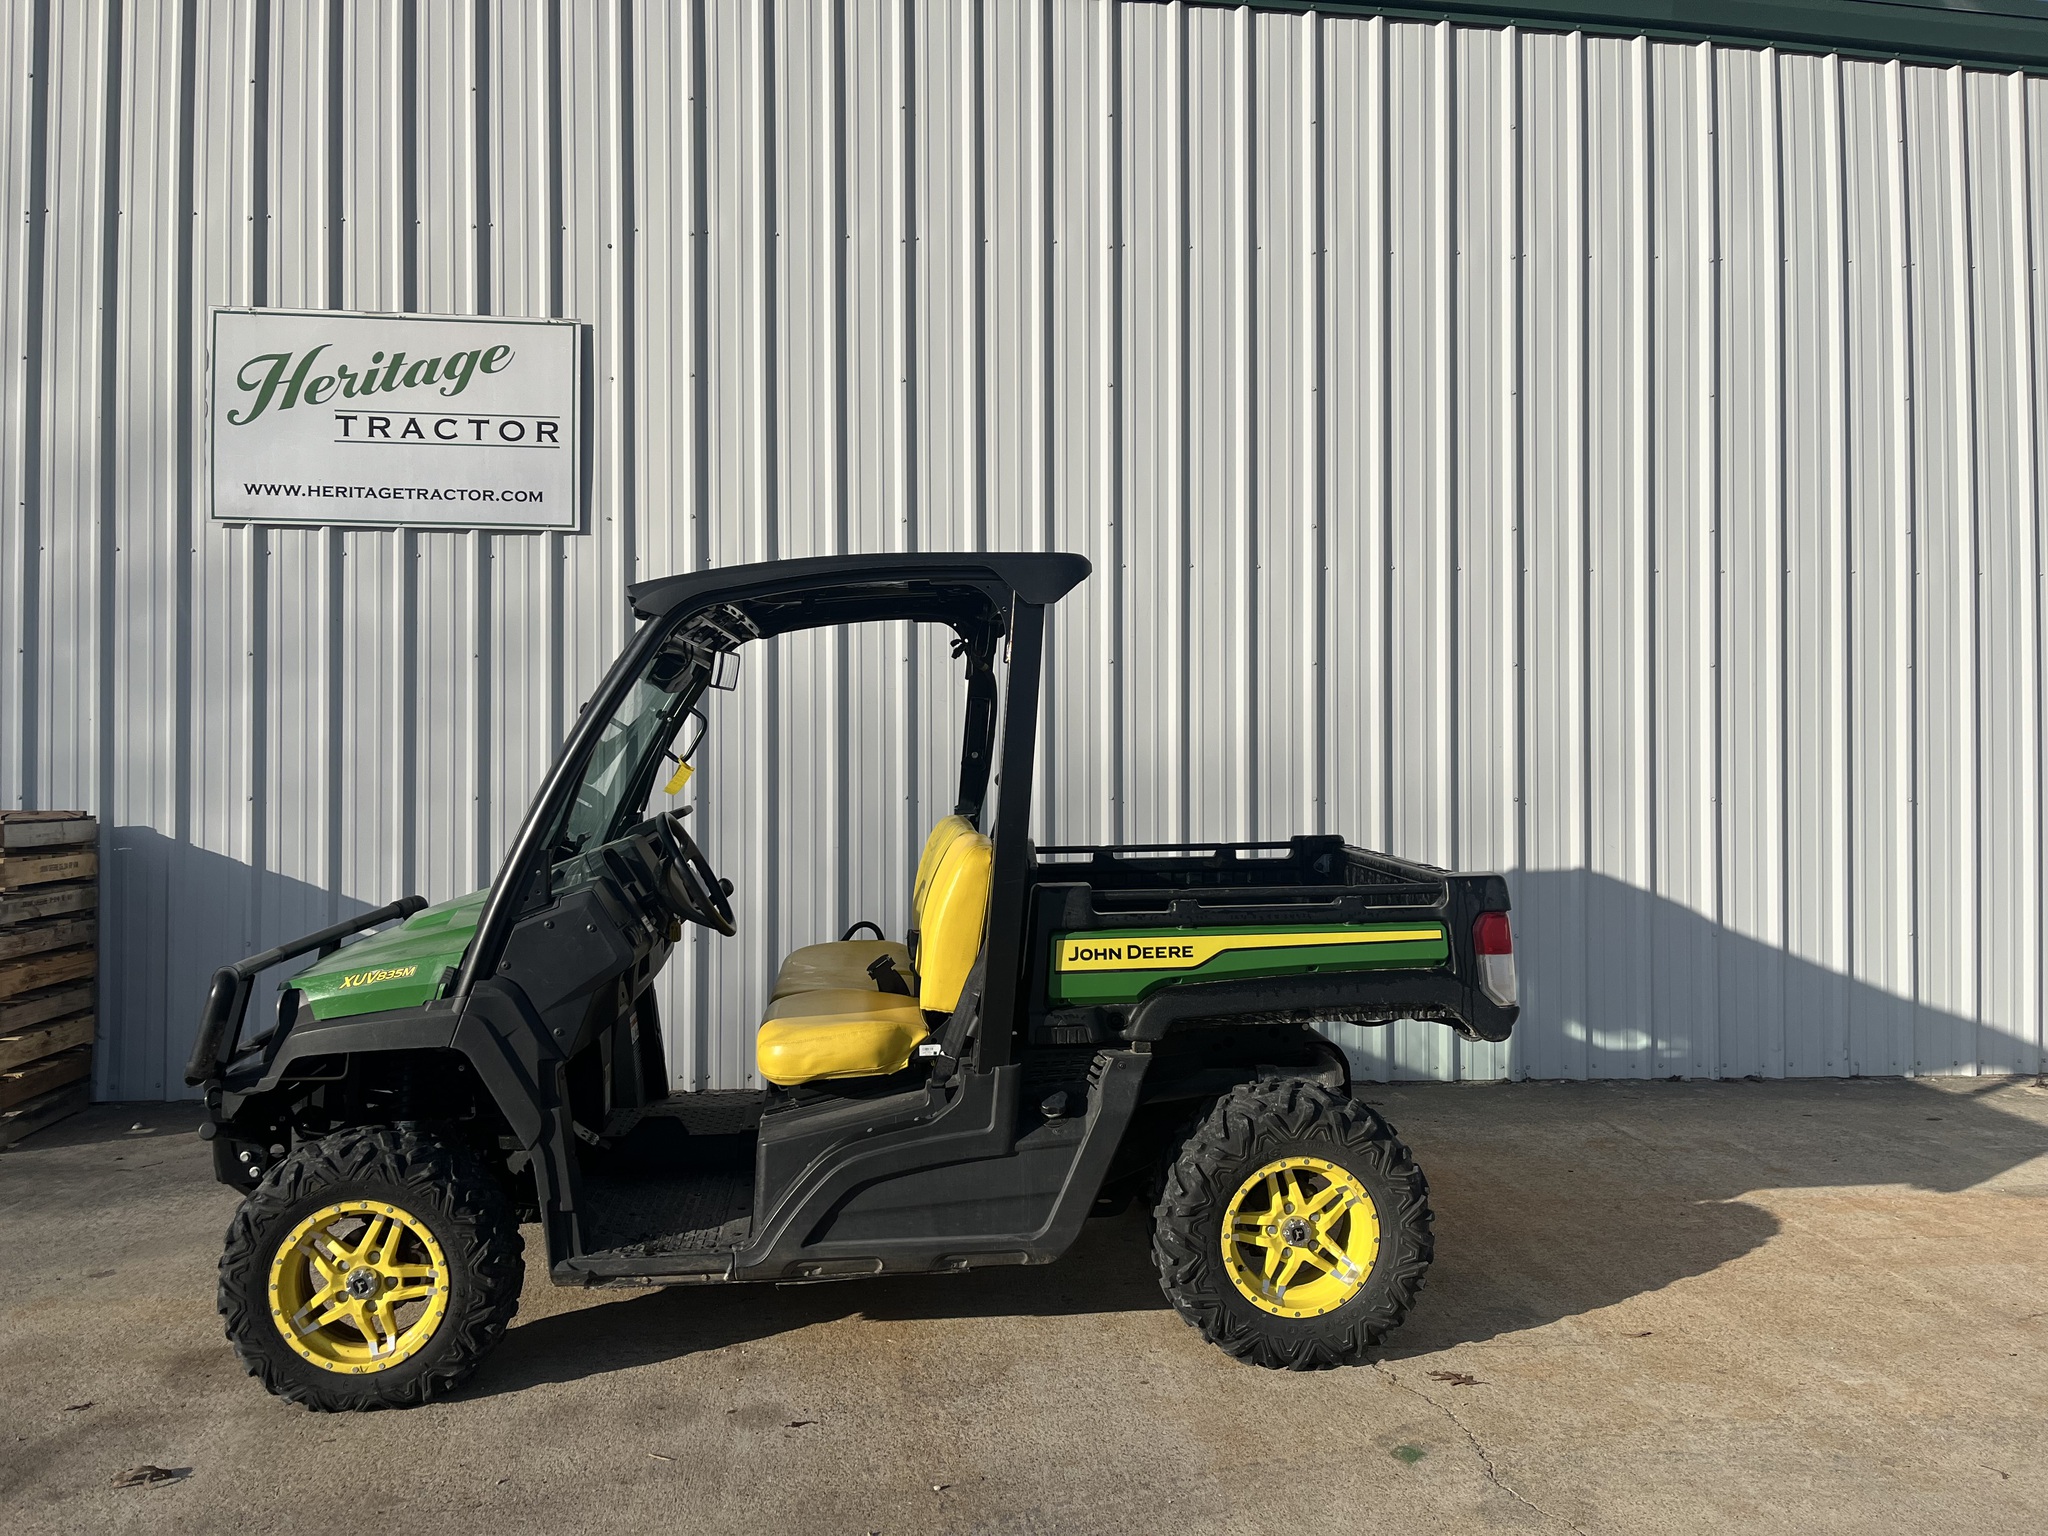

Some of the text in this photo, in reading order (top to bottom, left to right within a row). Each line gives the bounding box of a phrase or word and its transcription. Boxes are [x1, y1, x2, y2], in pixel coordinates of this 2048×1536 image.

[226, 343, 516, 426] Heritage
[334, 414, 559, 443] TRACTOR
[243, 482, 544, 503] WWW.HERITAGETRACTOR.COM
[1068, 944, 1194, 961] JOHN DEERE
[338, 966, 417, 989] XUV835M
